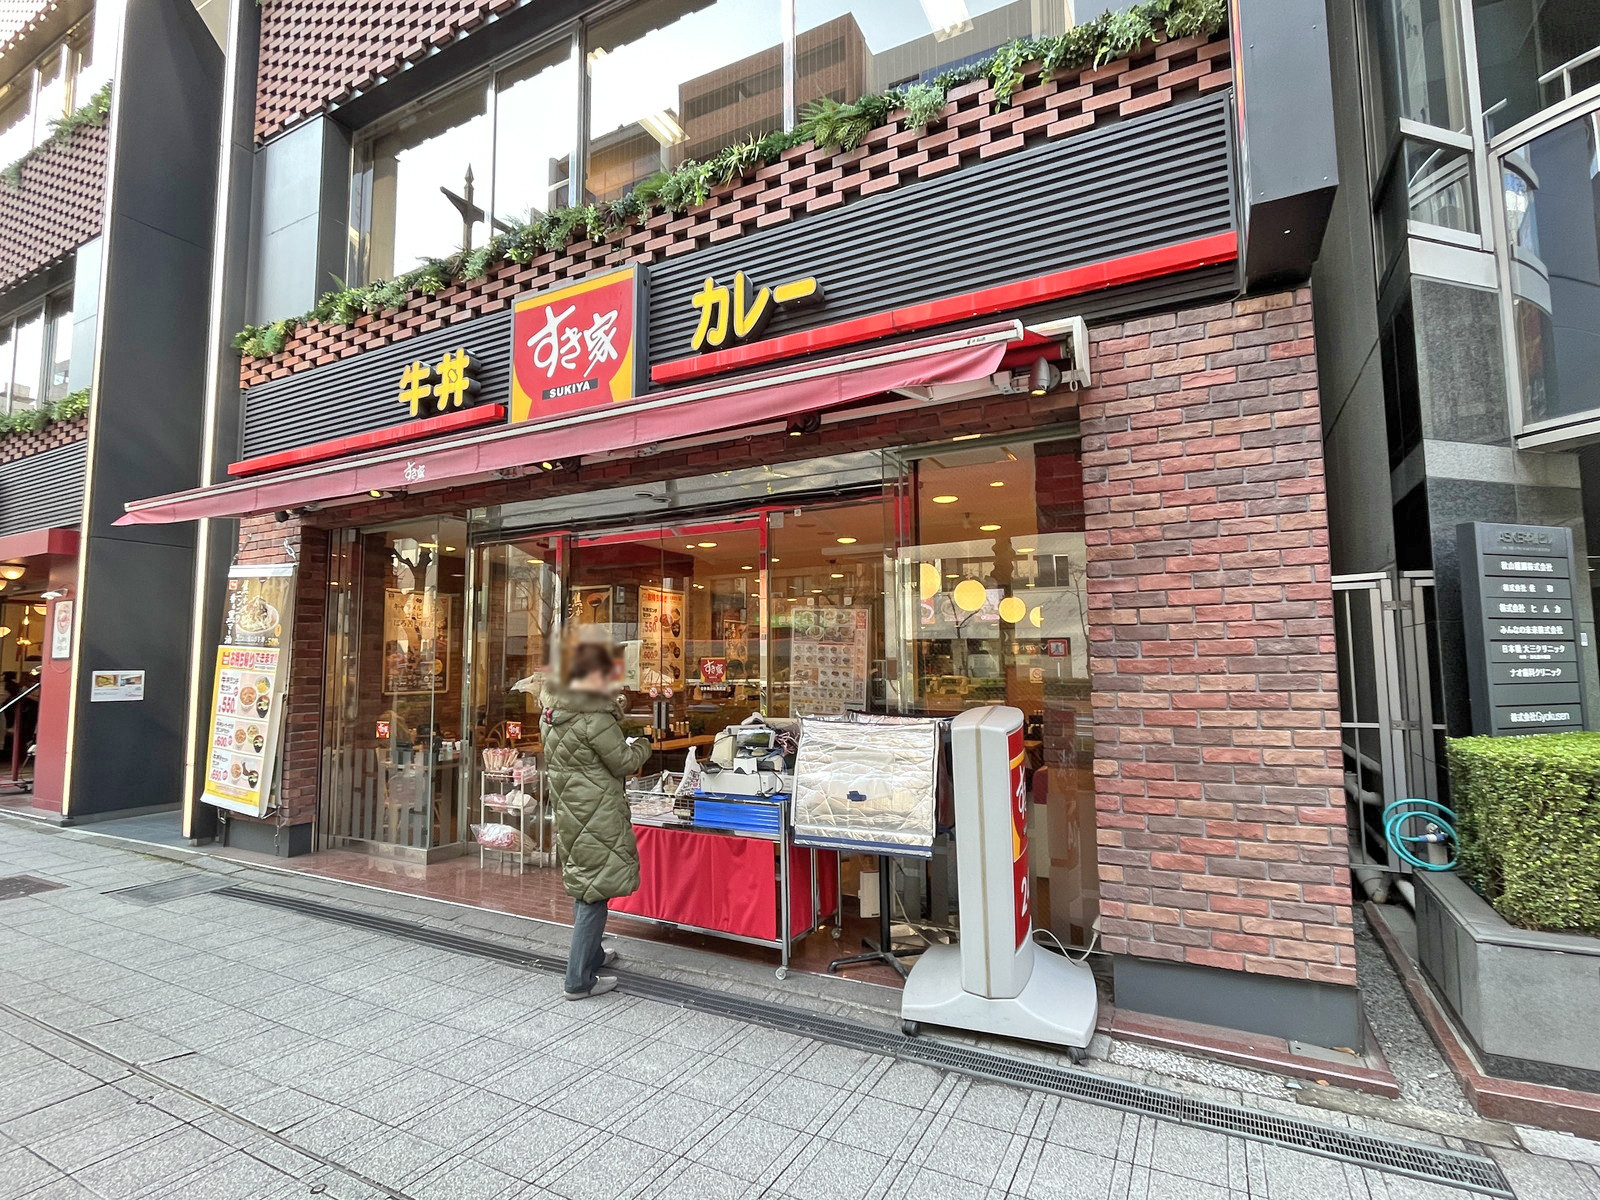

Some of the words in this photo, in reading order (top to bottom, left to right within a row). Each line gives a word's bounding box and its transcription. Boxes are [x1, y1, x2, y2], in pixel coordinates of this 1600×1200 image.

[691, 270, 817, 351] カレー
[527, 305, 619, 378] すき家
[398, 347, 471, 418] 牛丼
[549, 381, 591, 399] SUKIYA
[403, 461, 426, 482] すき家
[703, 660, 724, 676] すき家
